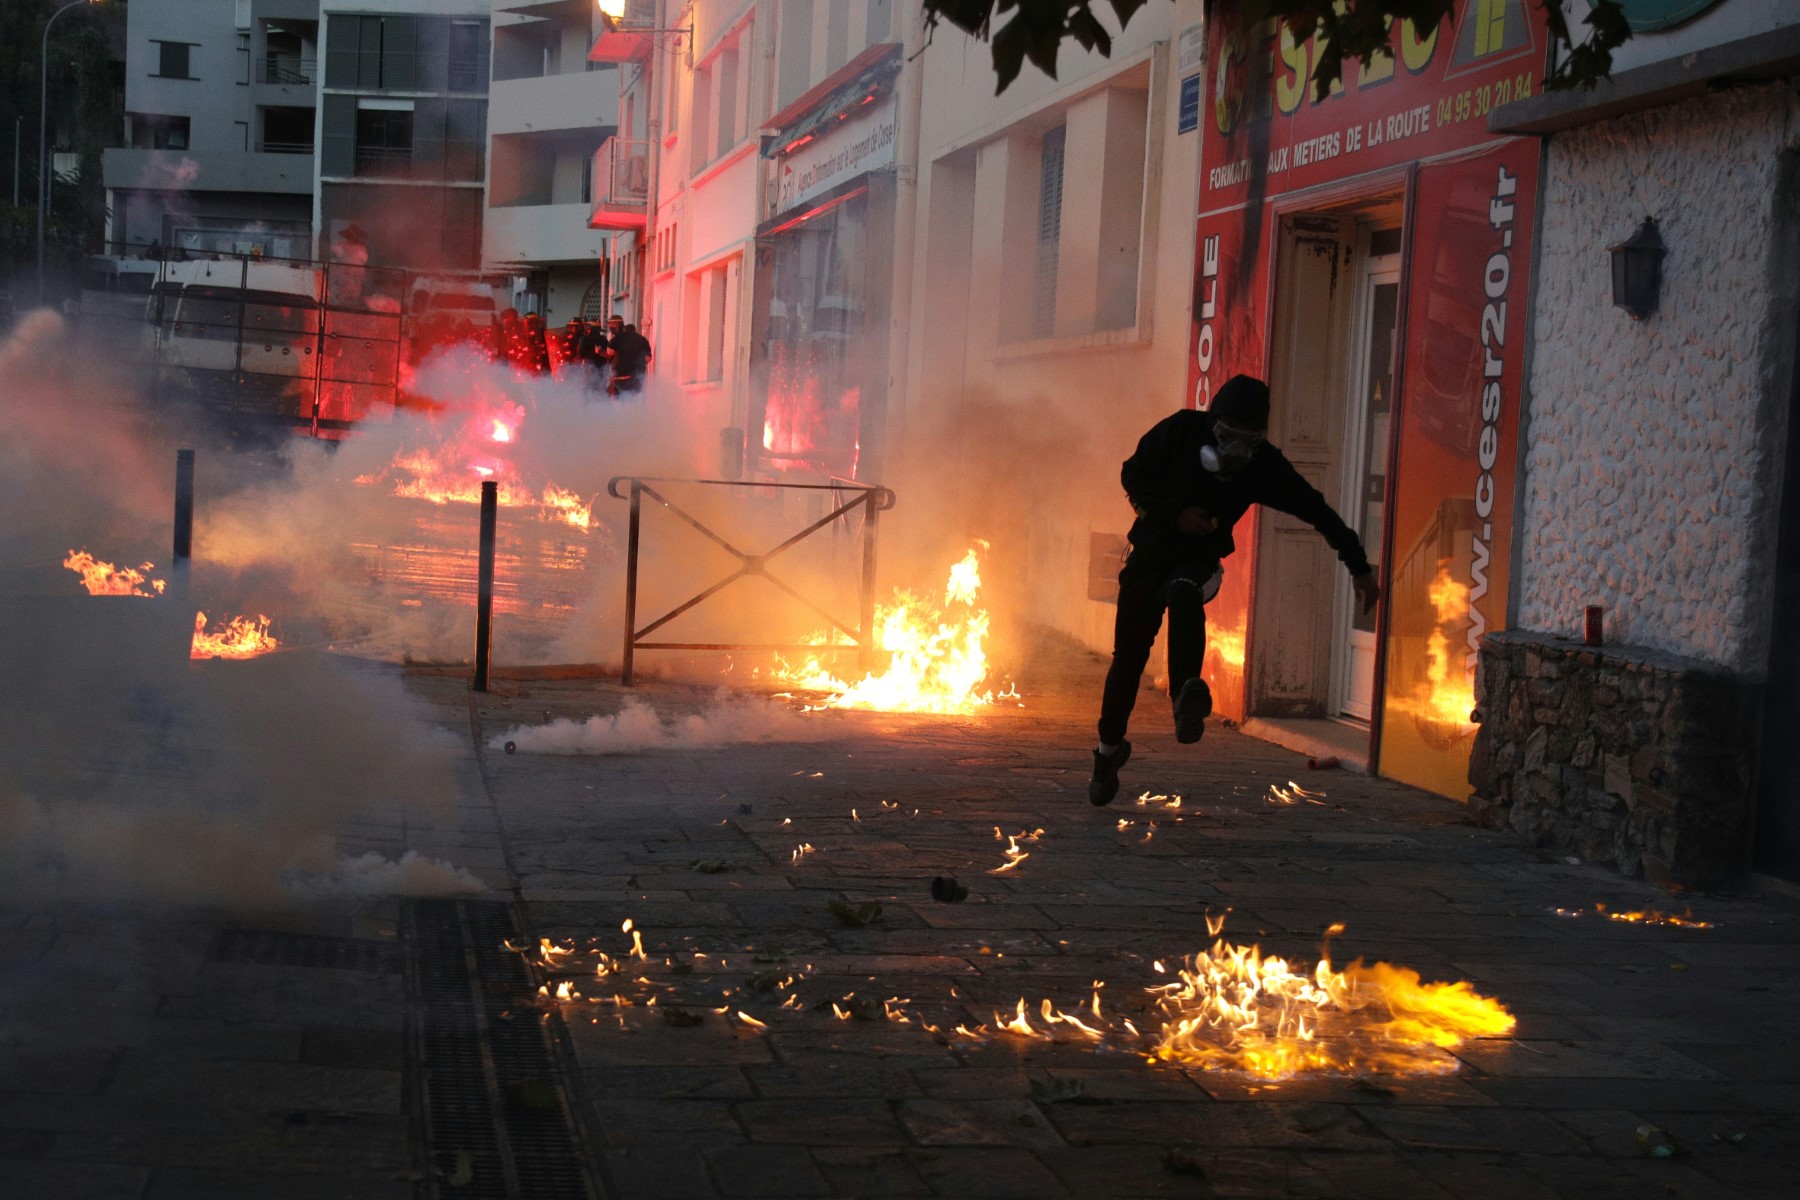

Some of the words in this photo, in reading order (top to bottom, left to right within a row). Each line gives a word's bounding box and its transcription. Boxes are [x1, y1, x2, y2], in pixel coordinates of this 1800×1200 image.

[1436, 98, 1451, 128] 04
[1455, 91, 1471, 123] 95
[1474, 84, 1490, 117] 30
[1494, 78, 1511, 107] 20
[1514, 71, 1532, 101] 84
[870, 128, 878, 153] de
[878, 124, 893, 150] Corse
[1267, 144, 1289, 175] AUX
[1293, 132, 1340, 167] METIERS
[1346, 125, 1362, 153] DE
[1368, 119, 1383, 148] LA
[1387, 105, 1431, 140] ROUTE
